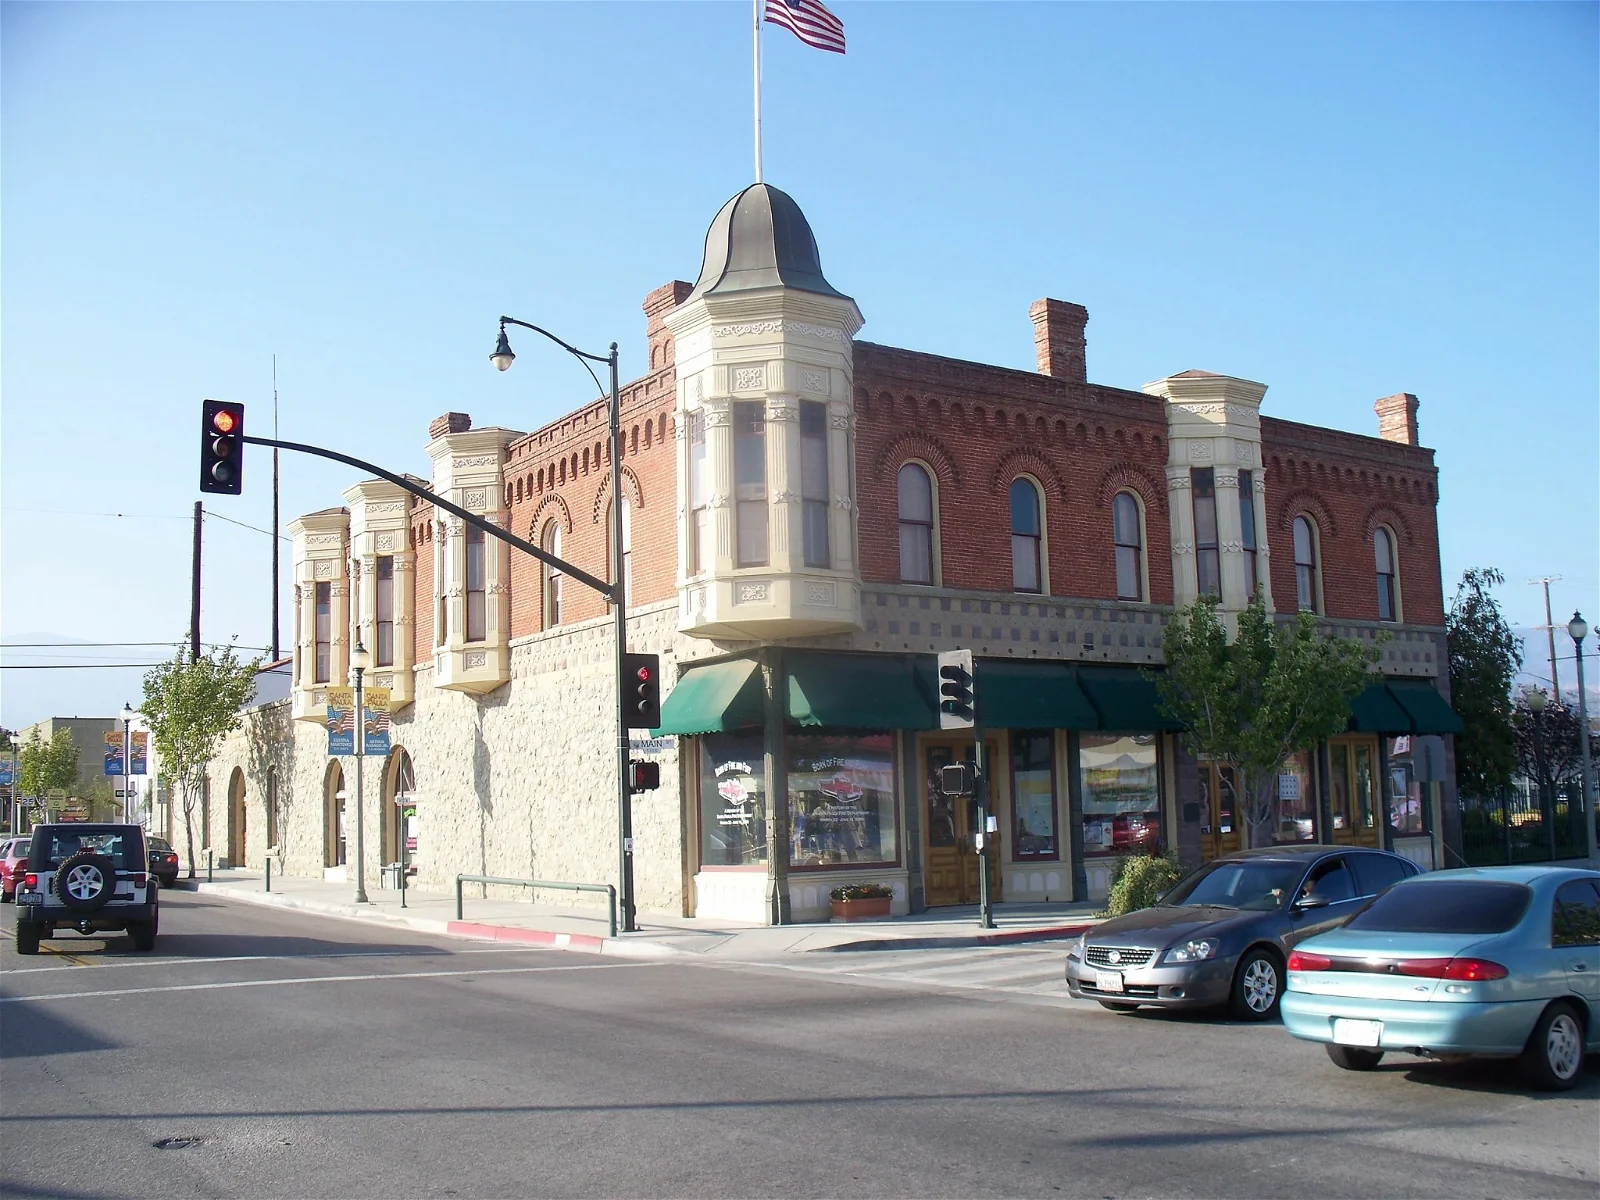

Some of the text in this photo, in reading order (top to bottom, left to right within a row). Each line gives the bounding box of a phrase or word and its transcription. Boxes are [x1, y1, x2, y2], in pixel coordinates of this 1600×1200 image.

[641, 740, 663, 748] MAIN
[811, 760, 827, 772] BORN
[826, 759, 833, 767] OF
[833, 757, 845, 767] FIRE
[22, 798, 34, 806] 25
